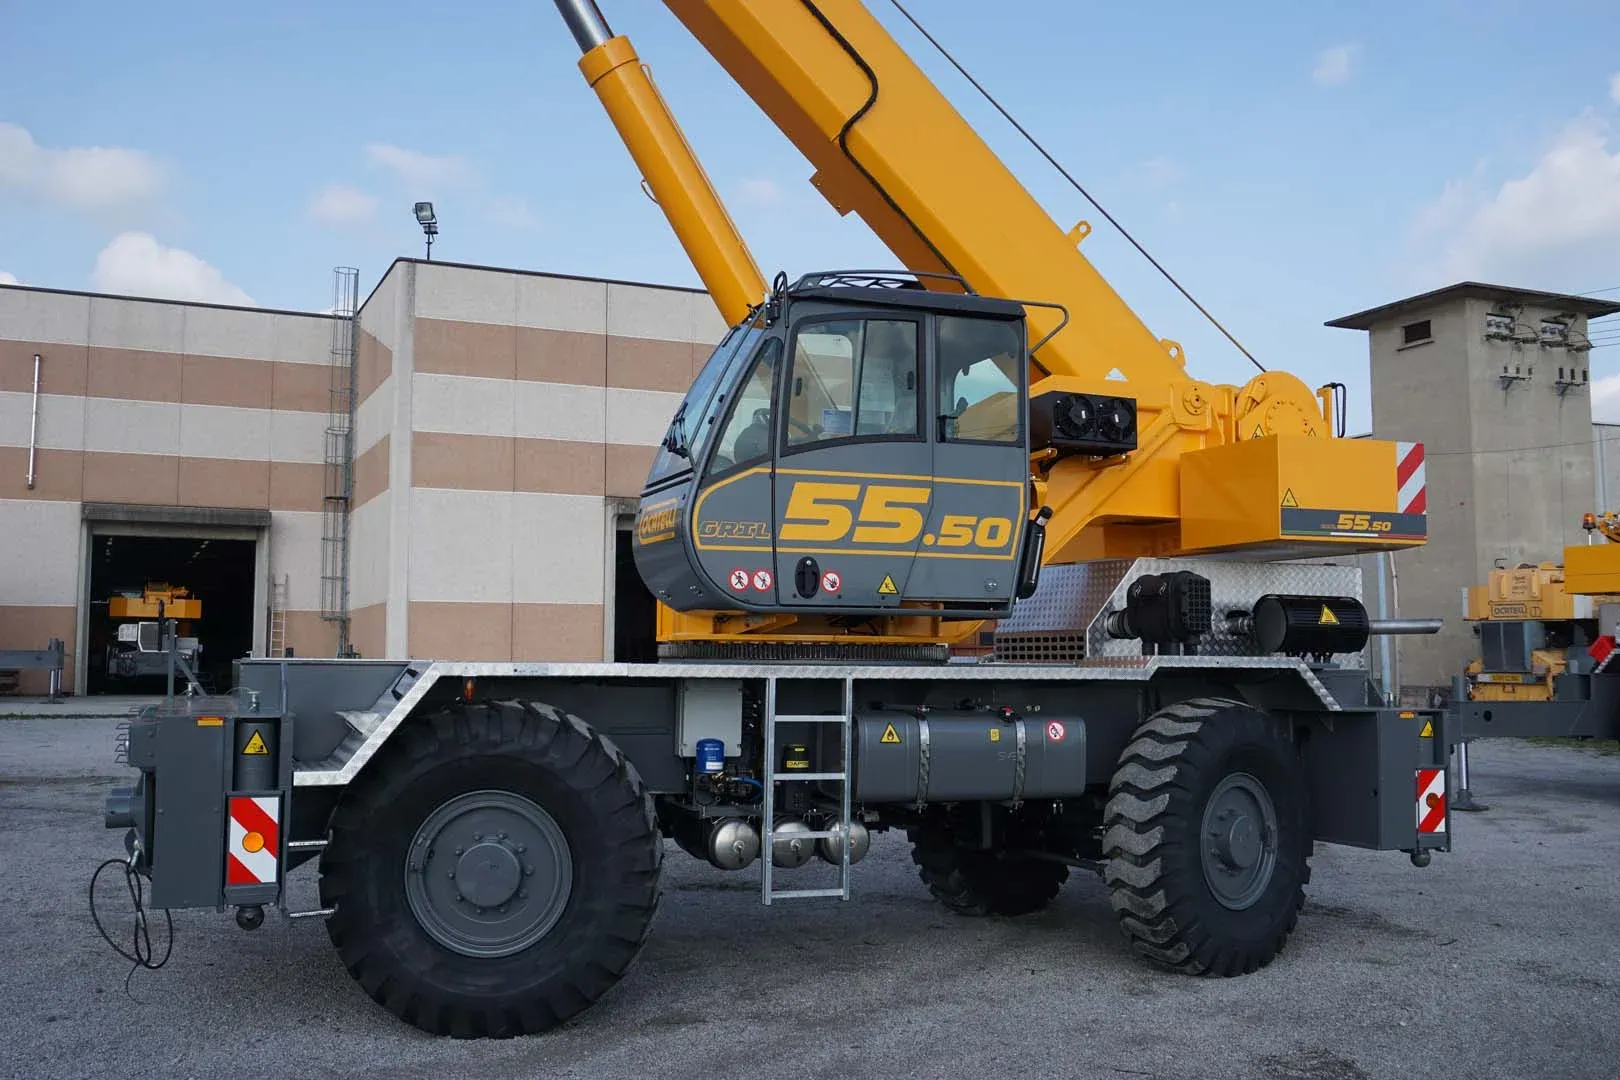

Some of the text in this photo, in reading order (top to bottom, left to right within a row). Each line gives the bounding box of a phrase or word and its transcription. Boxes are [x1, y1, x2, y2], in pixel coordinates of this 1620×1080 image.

[699, 481, 1013, 548] GRIL 55.50
[1337, 513, 1392, 532] 55.50
